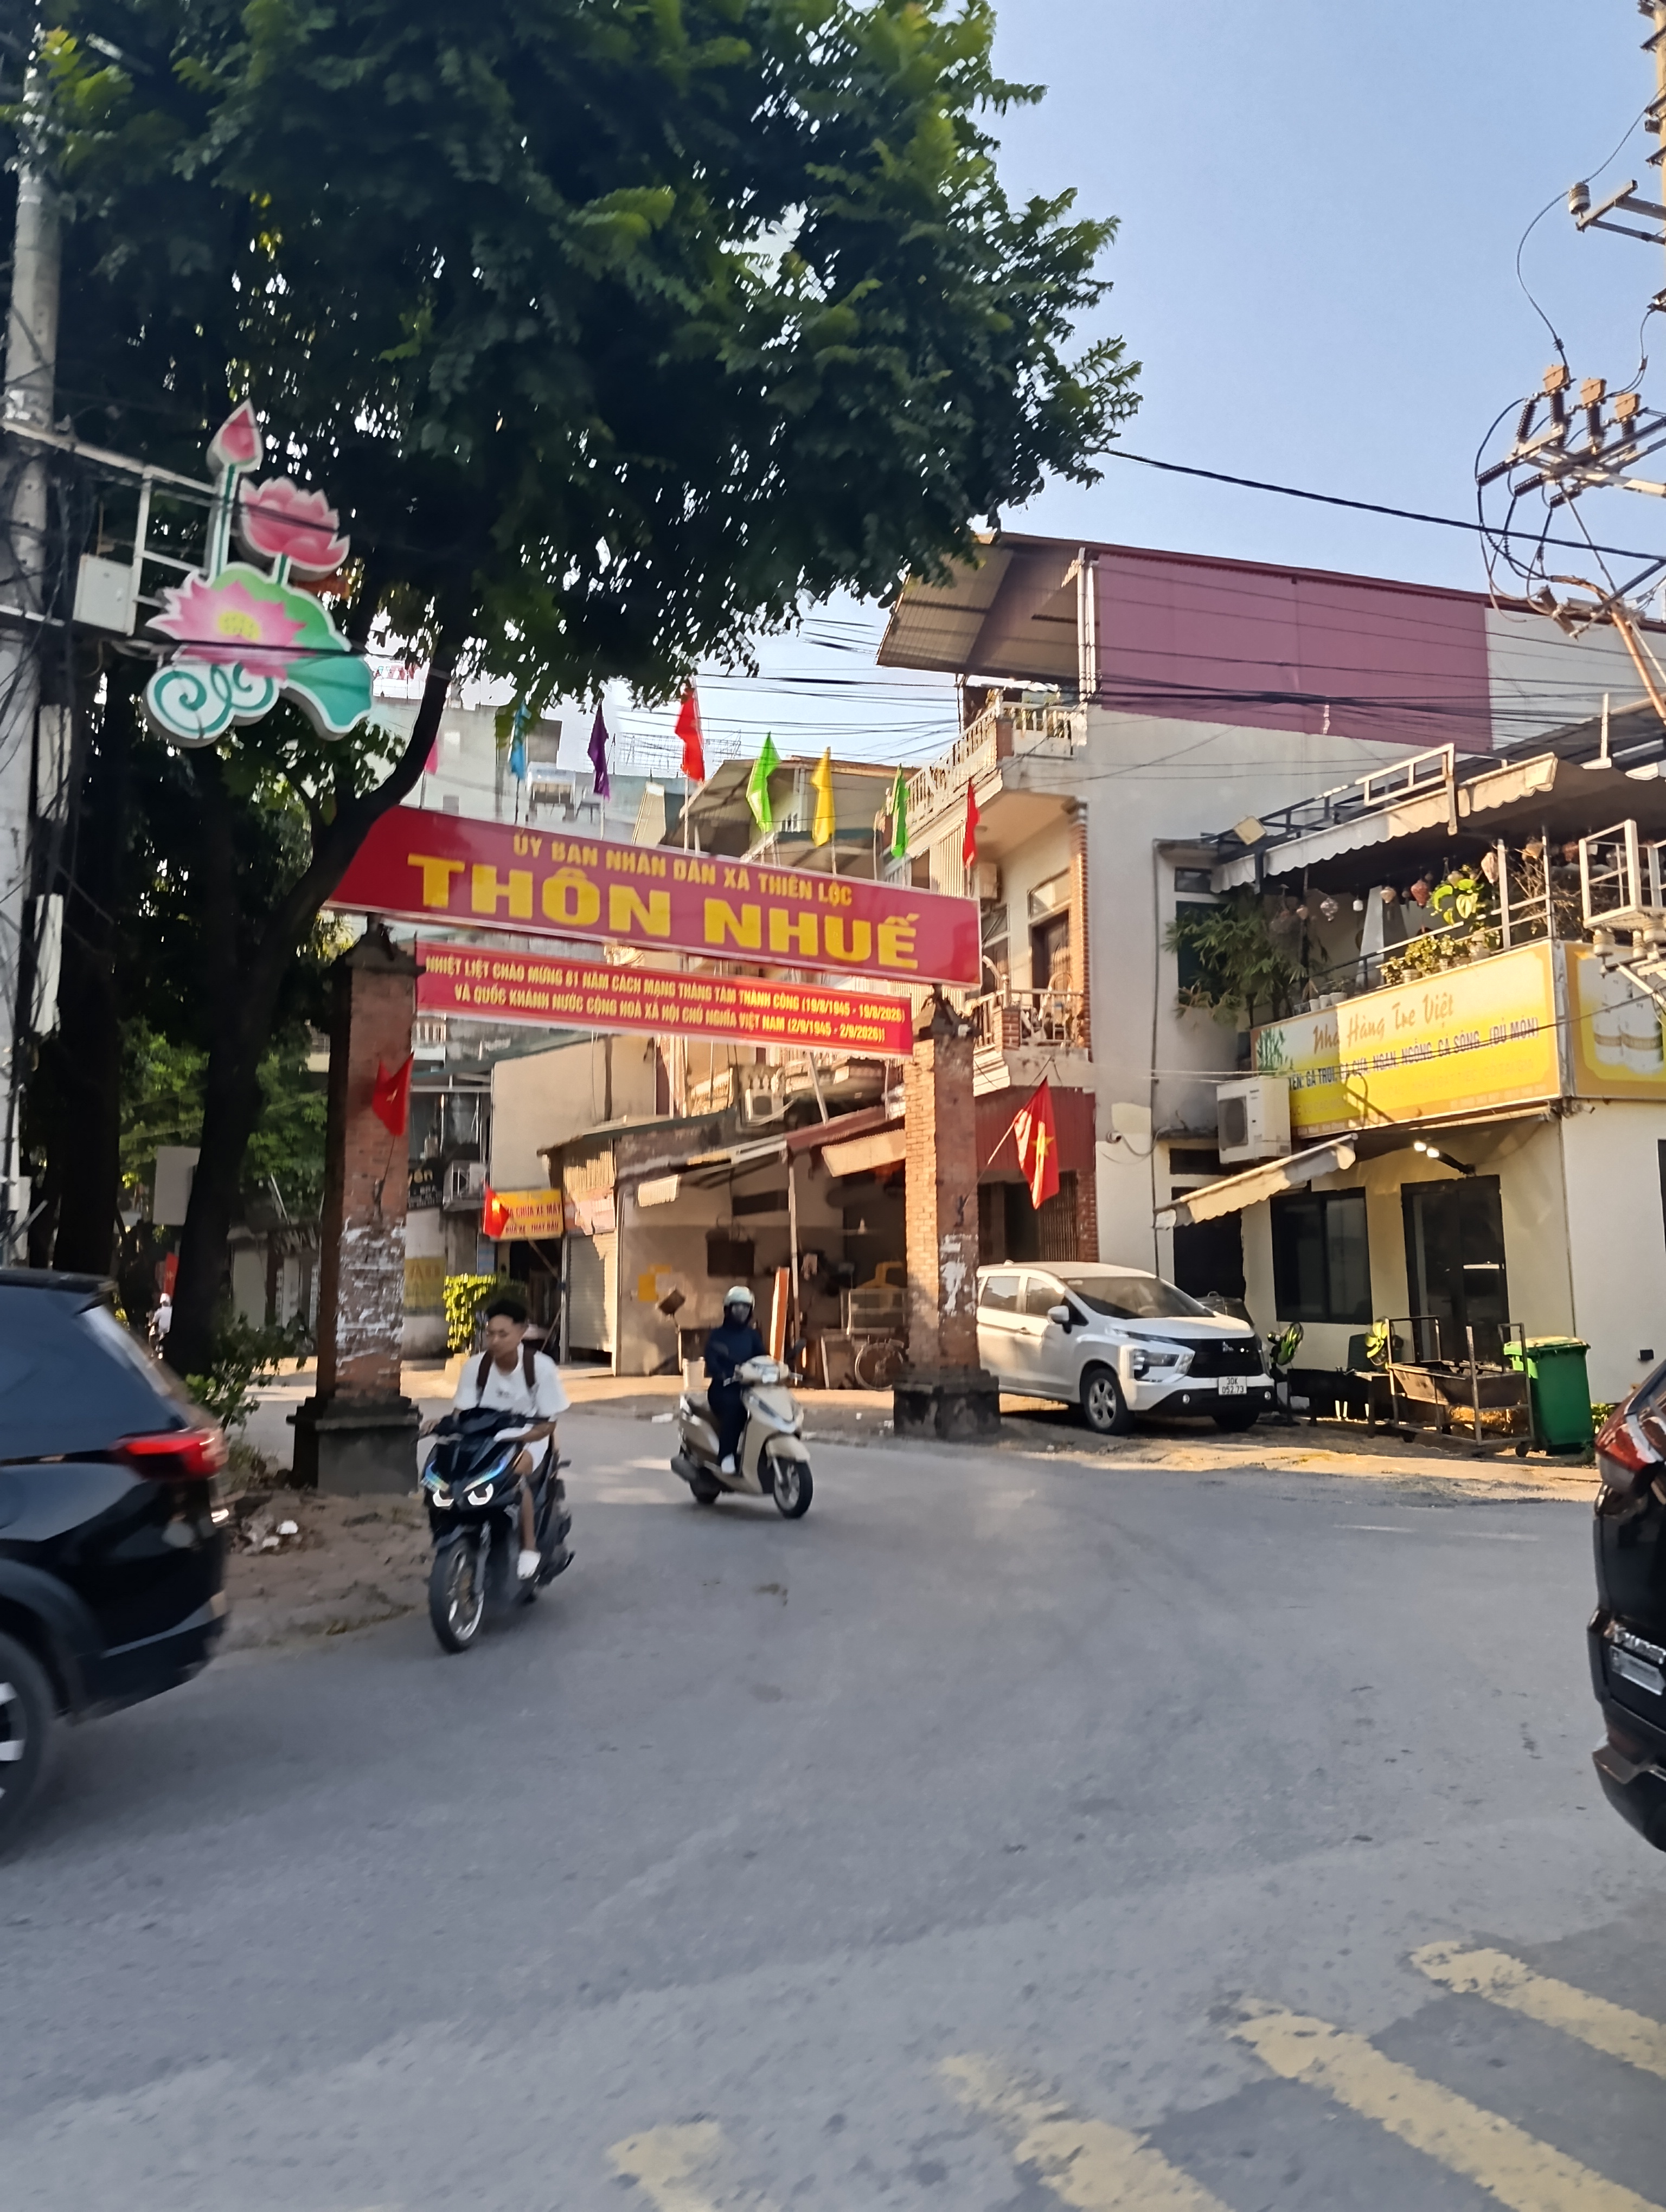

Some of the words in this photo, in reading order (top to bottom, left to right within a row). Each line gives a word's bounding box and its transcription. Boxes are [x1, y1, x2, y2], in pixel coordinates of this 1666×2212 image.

[552, 840, 598, 866] BAN
[606, 849, 667, 877] NHÂN
[673, 857, 716, 885] DÂN
[758, 873, 812, 901] THIÊN
[818, 880, 852, 906] LỘC
[407, 853, 671, 937] THÔN
[704, 897, 920, 969] NHUẾ
[425, 954, 462, 978] NHIỆT
[465, 956, 490, 981] LIỆT
[492, 961, 524, 982] CHÀO
[528, 963, 563, 986] MỪNG
[582, 970, 610, 992] NĂM
[611, 973, 642, 995] CÁCH
[643, 978, 676, 1001] MẠNG
[678, 981, 713, 1002] THÁNG
[714, 984, 736, 1005] TÁM
[738, 988, 771, 1009] THÀNH
[773, 991, 799, 1012] CÔNG
[802, 996, 850, 1018] (19/8/1945
[454, 981, 471, 1002] VÀ
[473, 982, 507, 1005] QUỐC
[509, 988, 549, 1010] KHÁNH
[552, 992, 584, 1013] NƯỚC
[586, 994, 617, 1018] CỘNG
[661, 1002, 680, 1025] HỘI
[682, 1004, 703, 1025] CHỦ
[739, 1011, 760, 1032] VIỆT
[762, 1014, 785, 1033] NAM
[787, 1017, 831, 1038] (2/9/1945
[1423, 992, 1453, 1028] Việt
[1222, 1385, 1244, 1394] 052.73
